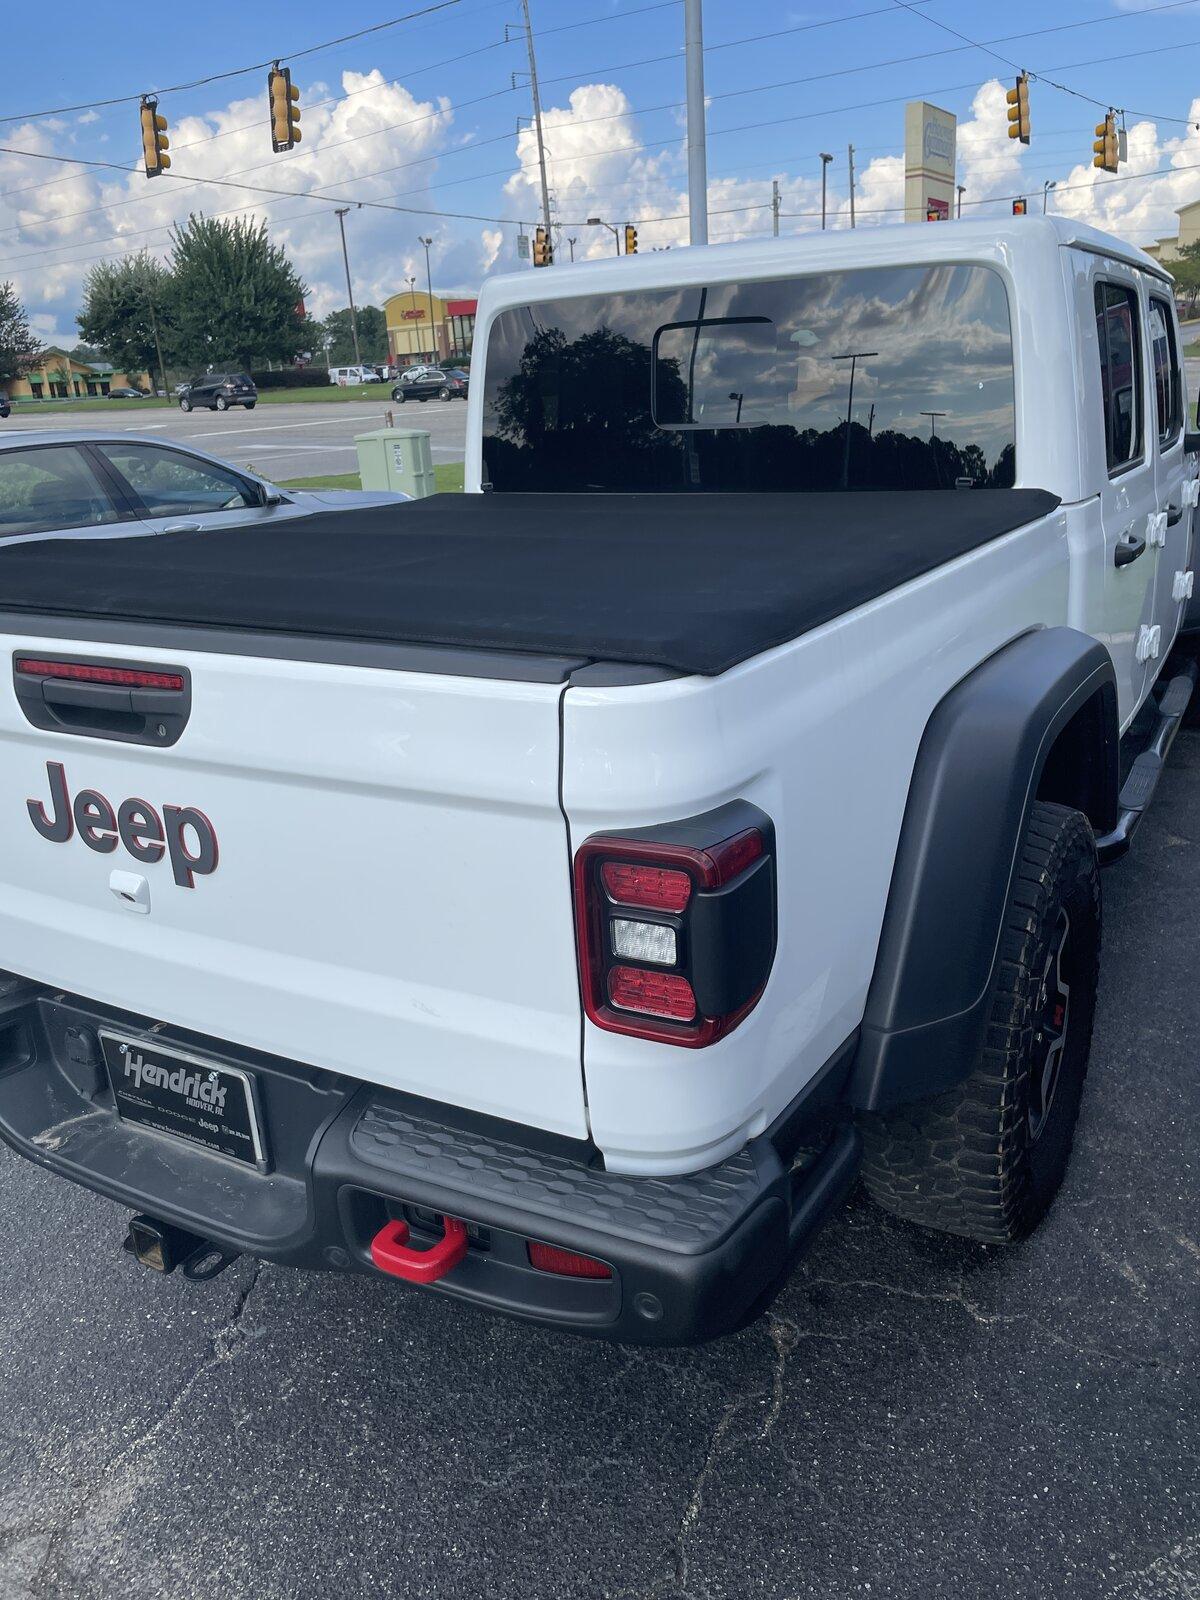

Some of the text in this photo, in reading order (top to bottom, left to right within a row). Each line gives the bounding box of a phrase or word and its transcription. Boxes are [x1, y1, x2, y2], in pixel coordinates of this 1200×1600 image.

[27, 761, 219, 888] Jeep
[124, 1051, 227, 1108] Hendrick
[198, 1117, 219, 1133] Jeep
